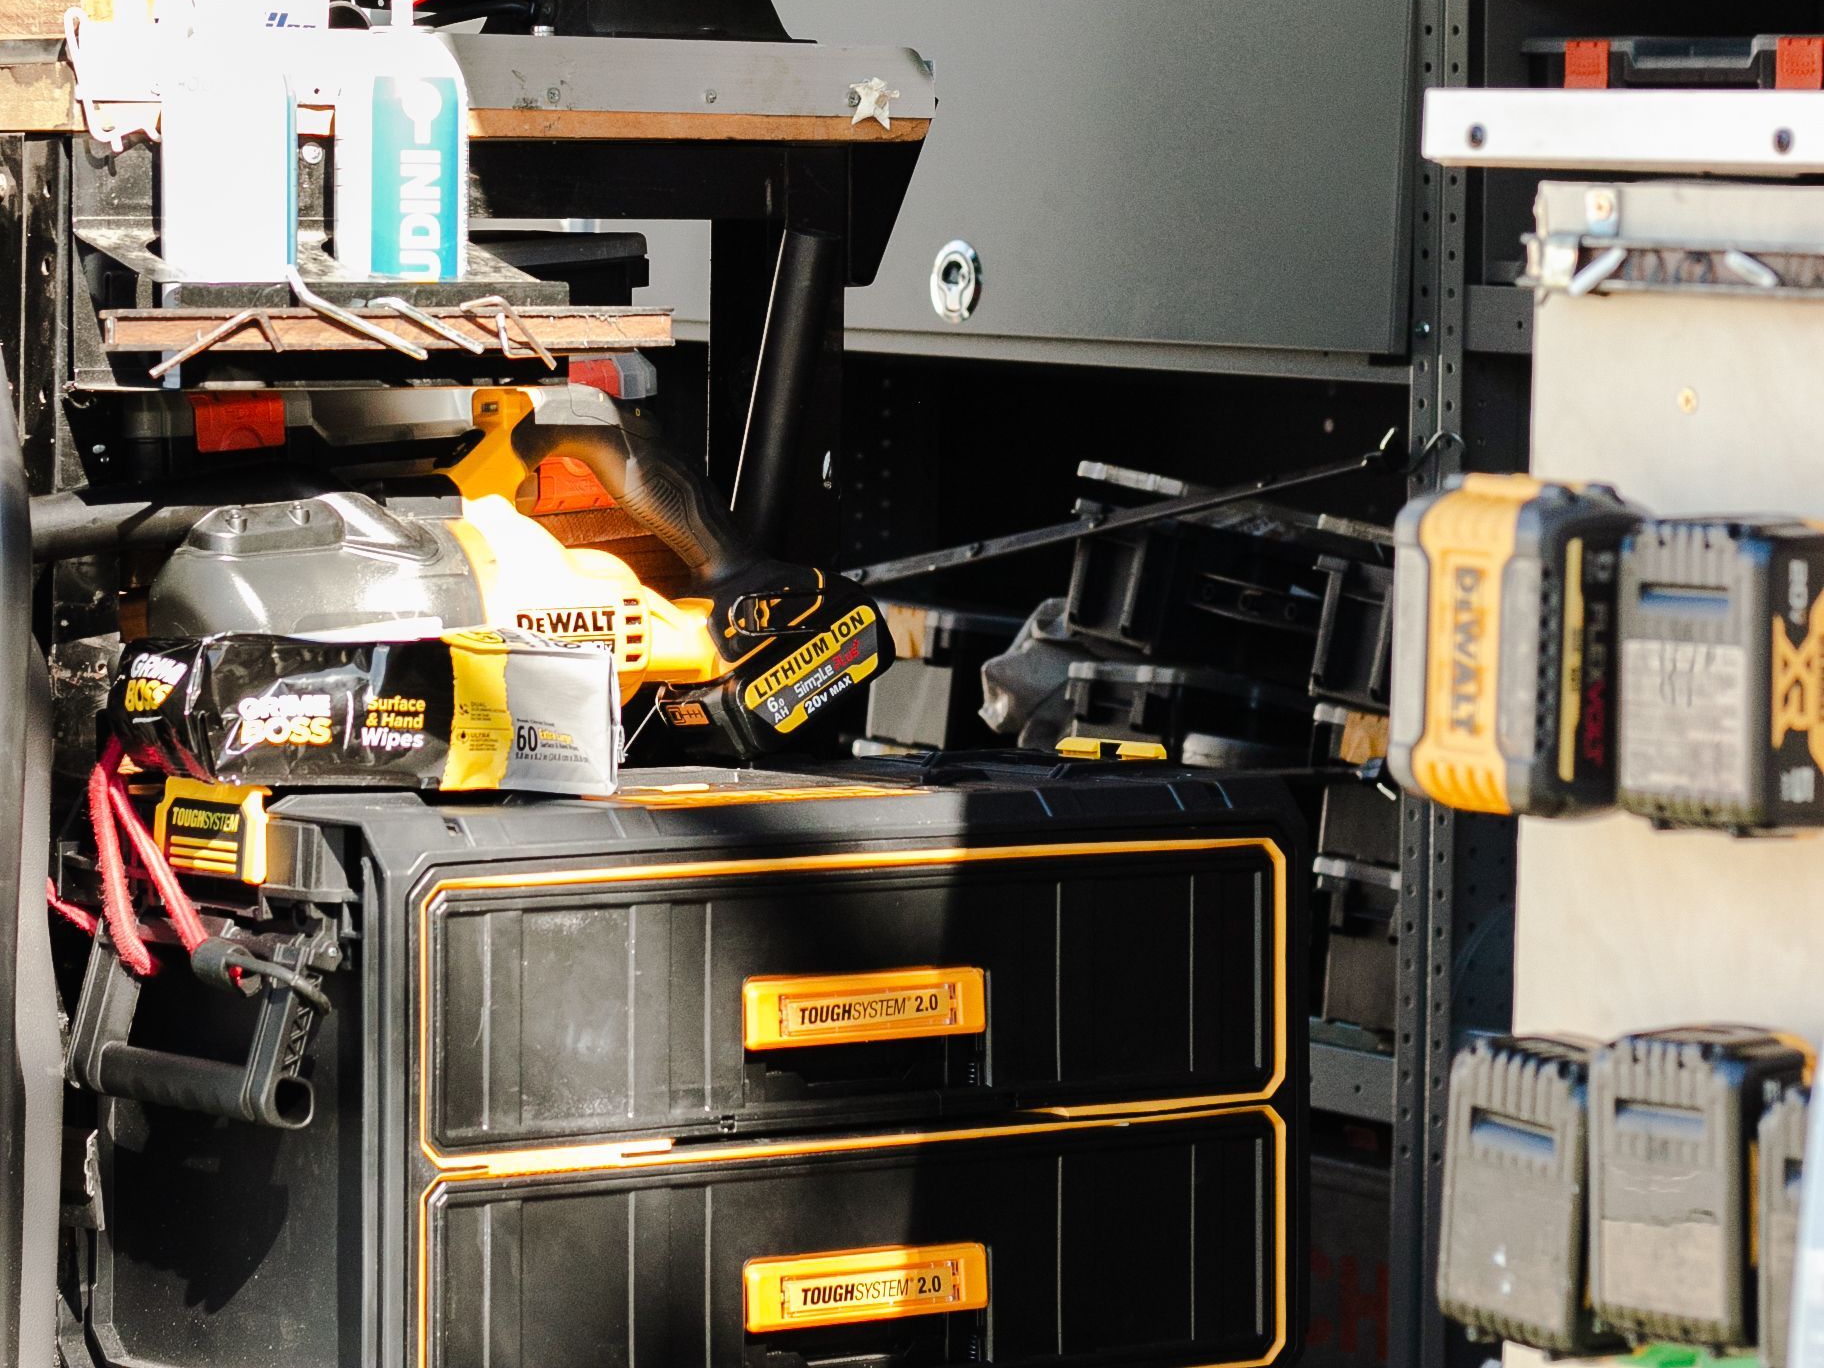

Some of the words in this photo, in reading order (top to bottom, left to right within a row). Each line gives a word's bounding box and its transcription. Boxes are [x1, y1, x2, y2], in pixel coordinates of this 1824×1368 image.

[516, 610, 615, 634] DEWALT
[754, 635, 830, 700] LITHIUM
[831, 610, 866, 644] ION
[1452, 566, 1482, 737] DEWALT
[124, 678, 175, 712] BOSS
[830, 675, 853, 697] MAX
[238, 694, 332, 720] GRIME
[367, 694, 427, 712] Surface
[773, 706, 791, 723] AH
[240, 716, 333, 746] BOSS
[365, 712, 378, 728] &
[381, 712, 425, 729] Hand
[361, 727, 425, 751] Wipes
[516, 725, 538, 752] 60
[171, 806, 241, 833] TOUGHSYSTEM
[799, 996, 908, 1026] TOUGHSYSTEM
[914, 992, 940, 1013] 2.0
[801, 1277, 910, 1306] TOUGHSYSTEM
[916, 1274, 942, 1295] 2.0
